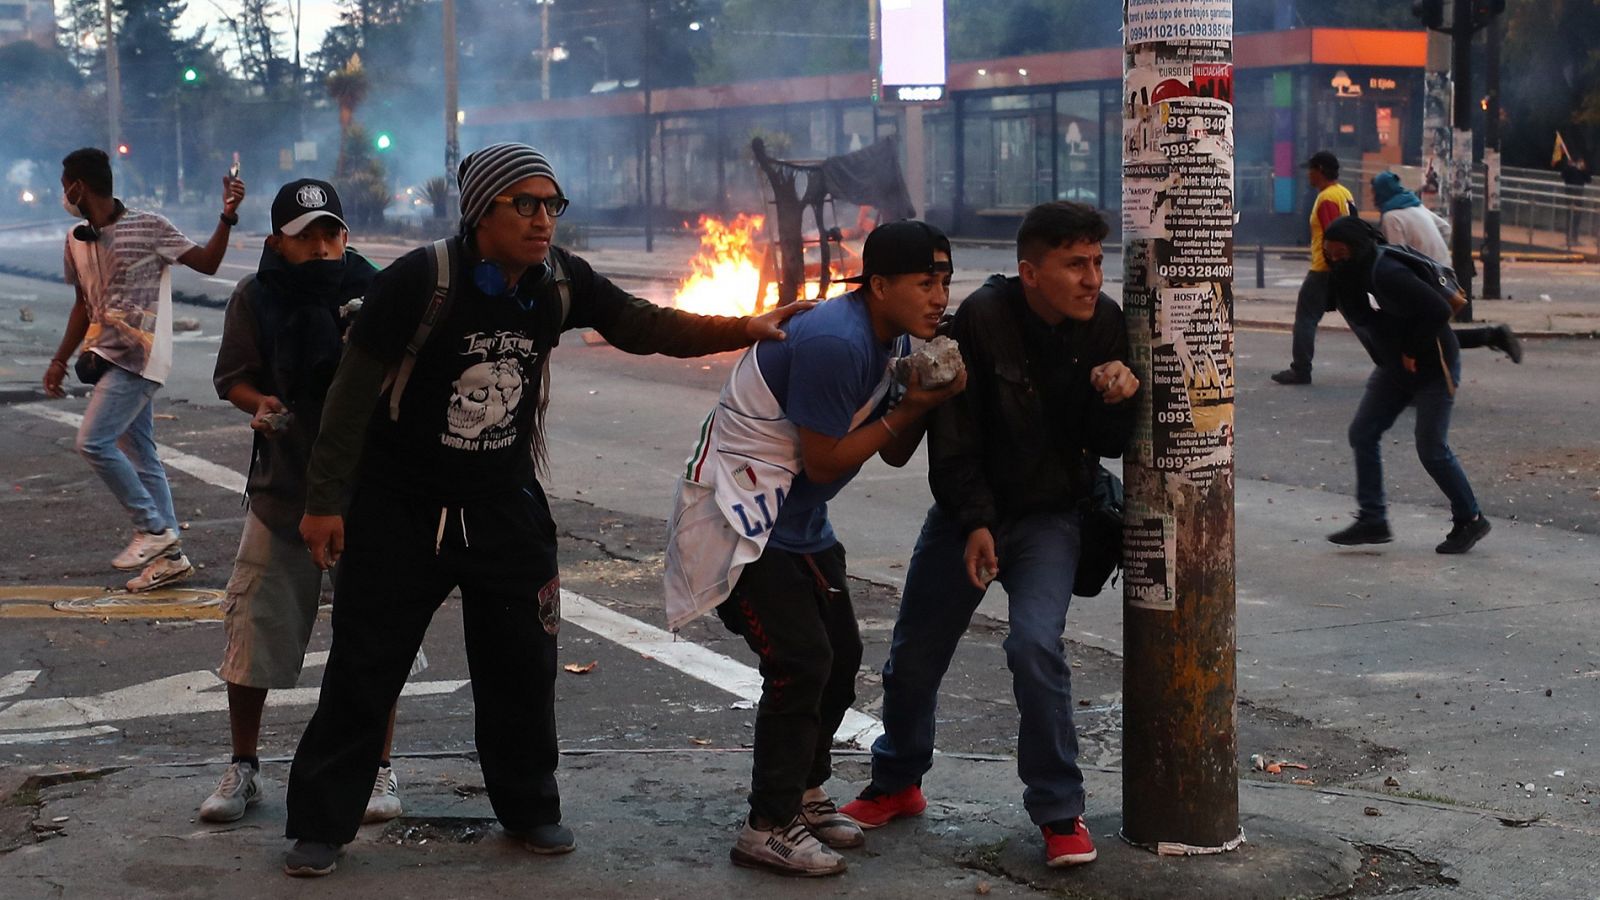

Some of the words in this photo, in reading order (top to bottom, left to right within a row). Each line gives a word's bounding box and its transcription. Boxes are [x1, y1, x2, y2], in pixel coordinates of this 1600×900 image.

[1145, 9, 1158, 20] todo
[1160, 7, 1172, 21] tipo
[1174, 7, 1182, 18] de
[1183, 7, 1209, 20] trabajos
[1159, 66, 1181, 78] CURSO
[1183, 66, 1192, 77] DE
[1187, 228, 1194, 238] el
[1169, 256, 1194, 265] Limpias
[1159, 264, 1233, 278] 0993284097
[1196, 320, 1214, 335] Brujo
[1154, 373, 1171, 384] Único
[440, 432, 480, 451] URBAN
[1176, 438, 1199, 446] Lectura
[1166, 447, 1190, 456] Limpias
[765, 836, 794, 859] PUMA
